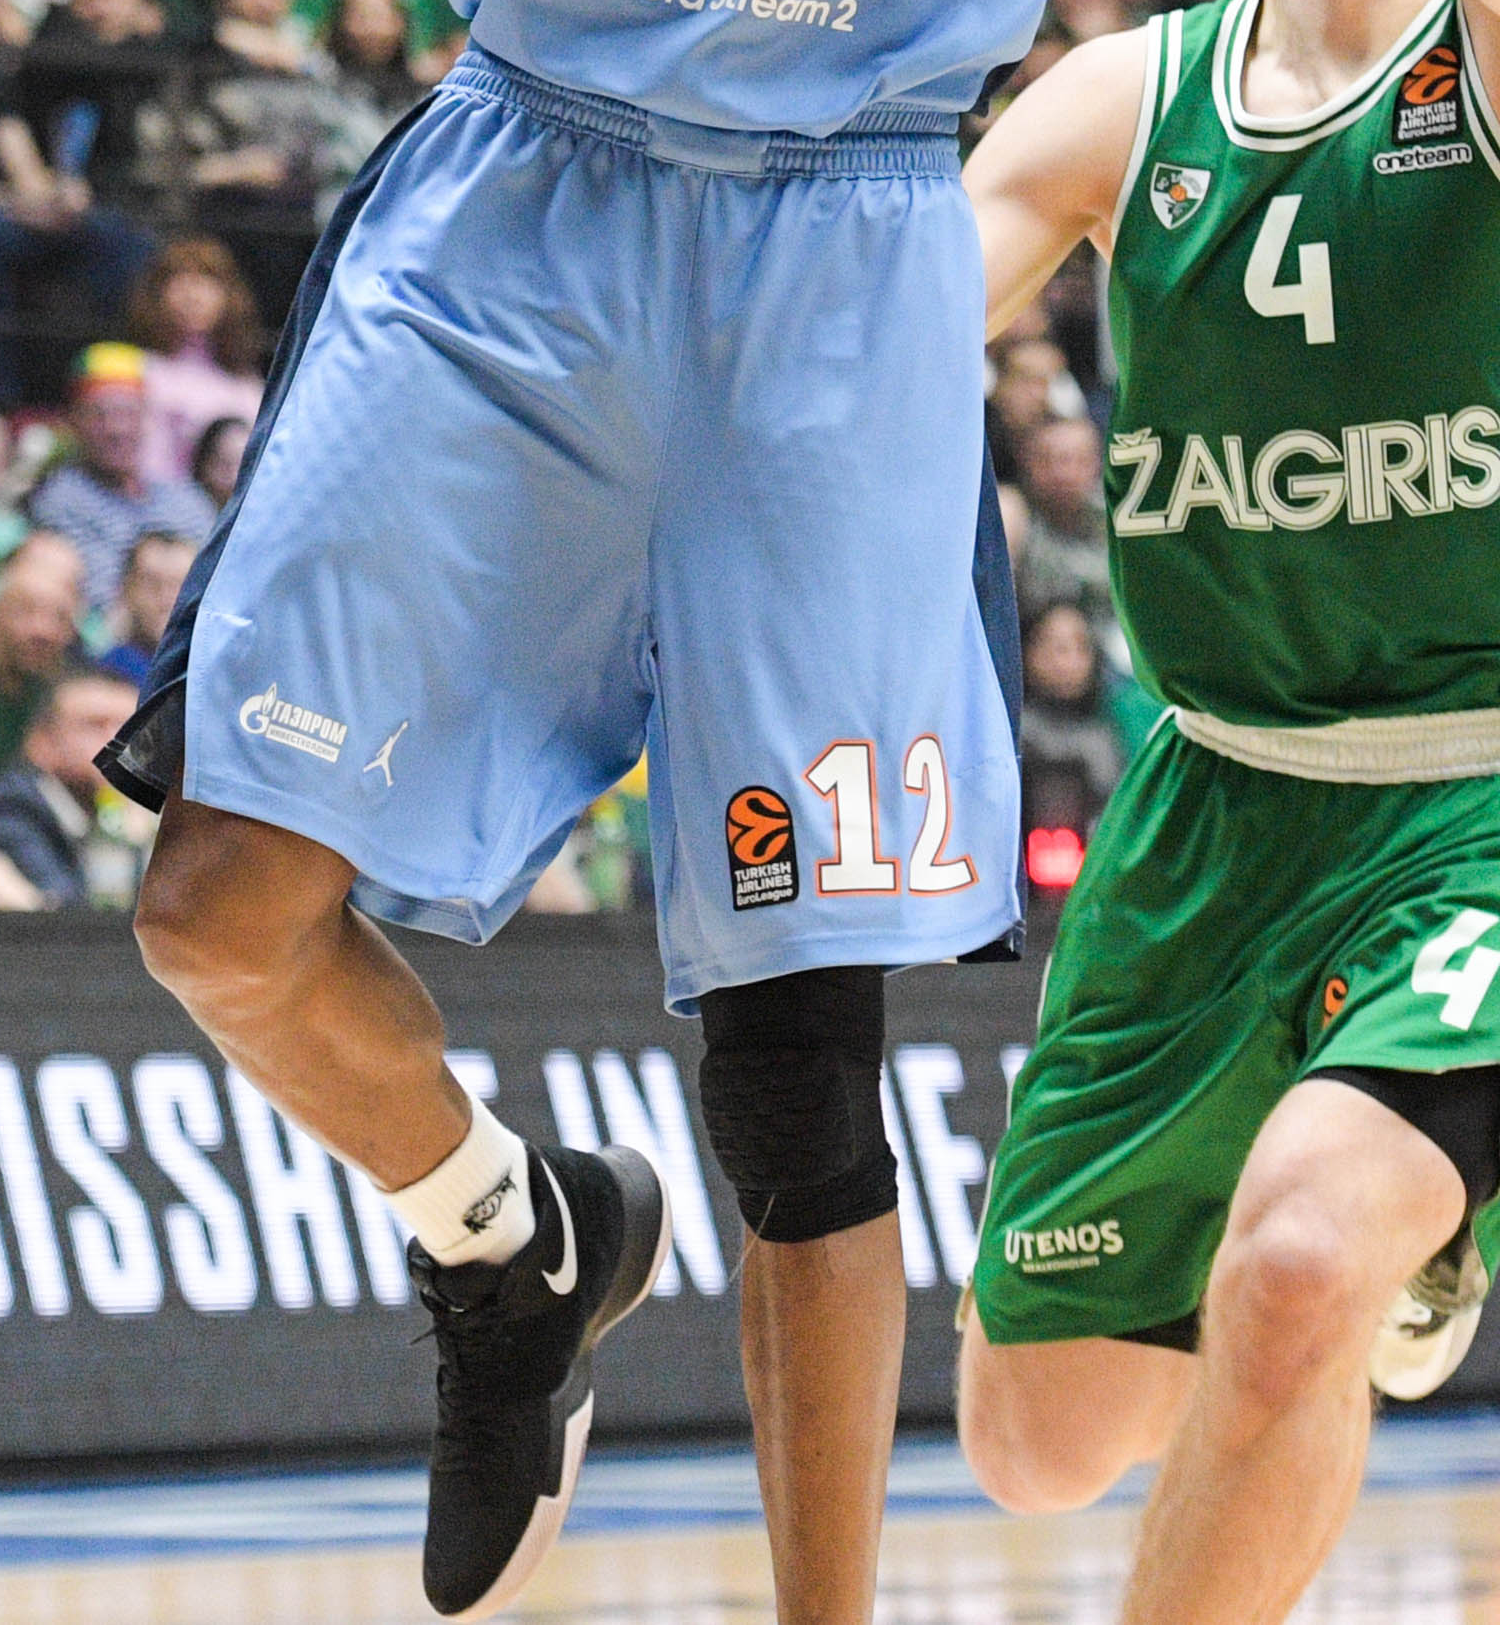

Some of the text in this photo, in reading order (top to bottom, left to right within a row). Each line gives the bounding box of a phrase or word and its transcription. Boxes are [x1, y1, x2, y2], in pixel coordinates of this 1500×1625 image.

[1399, 100, 1457, 121] TURKISH
[1399, 111, 1457, 130] AIRLINES
[1376, 146, 1470, 171] oneteam
[1243, 193, 1336, 345] 4
[271, 699, 348, 745] ГАЗПРОМ
[802, 731, 980, 899] 12
[733, 861, 792, 882] TURKISH
[736, 874, 793, 894] AIRLINES
[736, 887, 794, 907] EuroLeague
[1003, 1218, 1124, 1265] UTENOS
